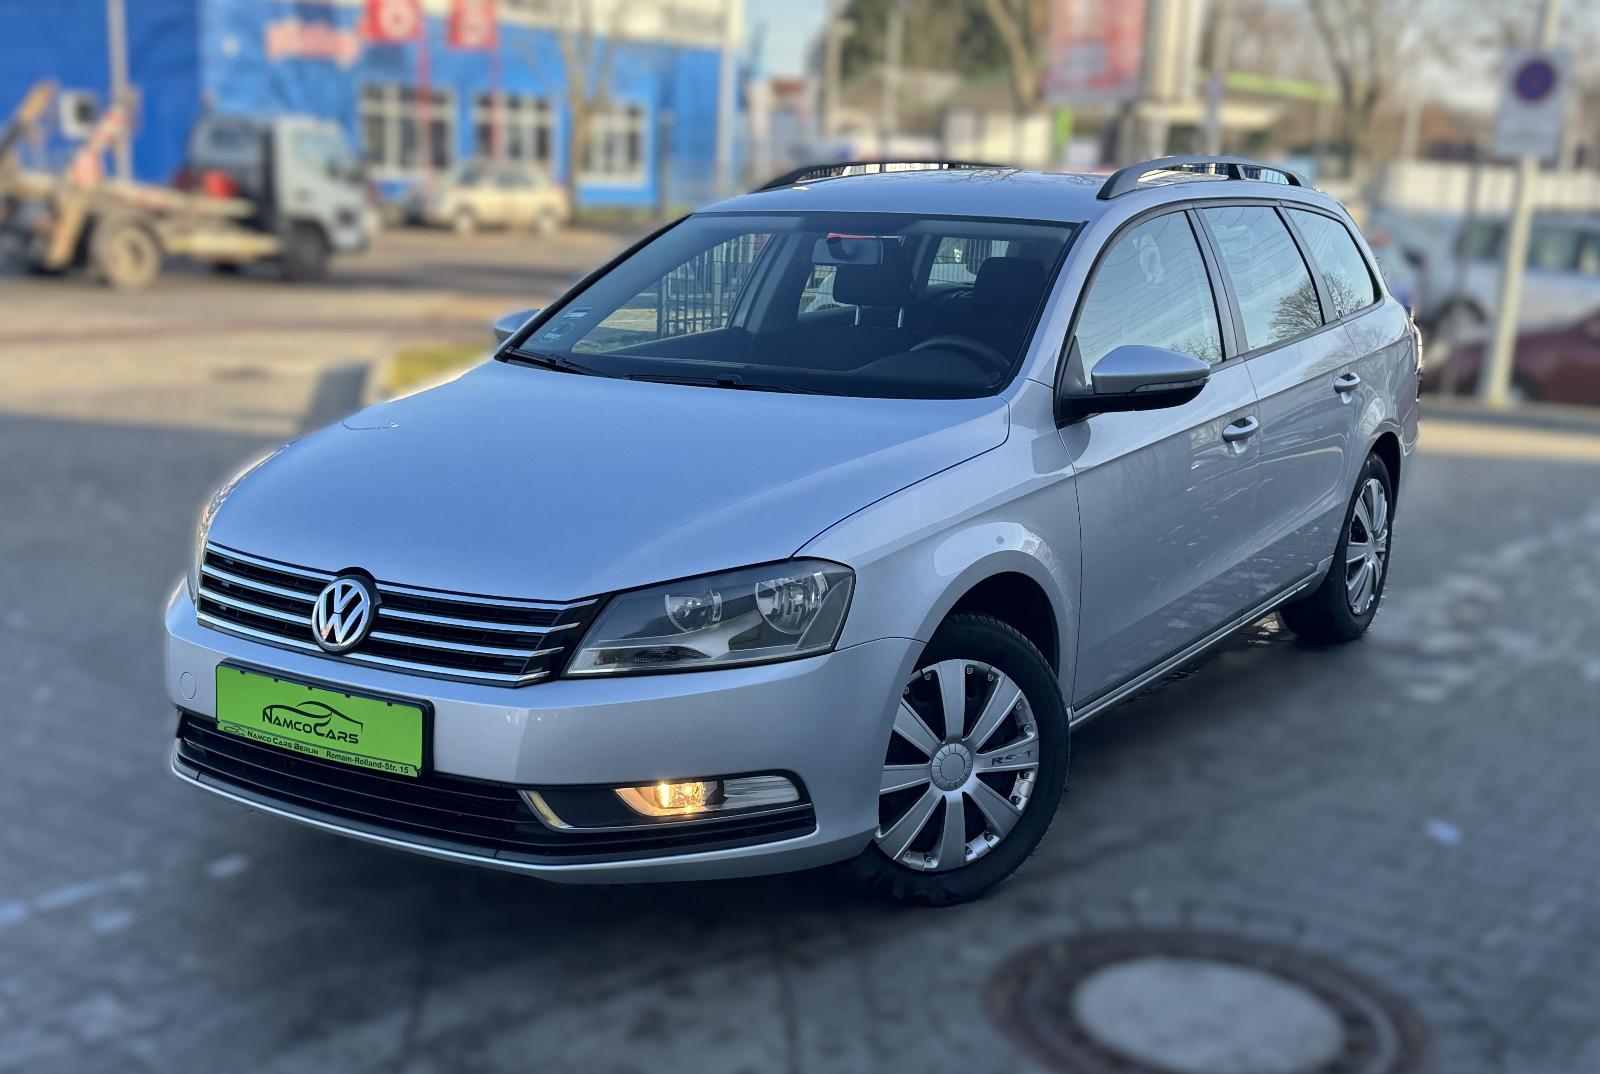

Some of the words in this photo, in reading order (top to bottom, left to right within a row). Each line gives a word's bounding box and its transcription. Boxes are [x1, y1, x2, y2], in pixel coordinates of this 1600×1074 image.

[312, 579, 369, 649] VW
[326, 750, 398, 772] Romain-Rolland-Str.
[400, 766, 409, 774] 15
